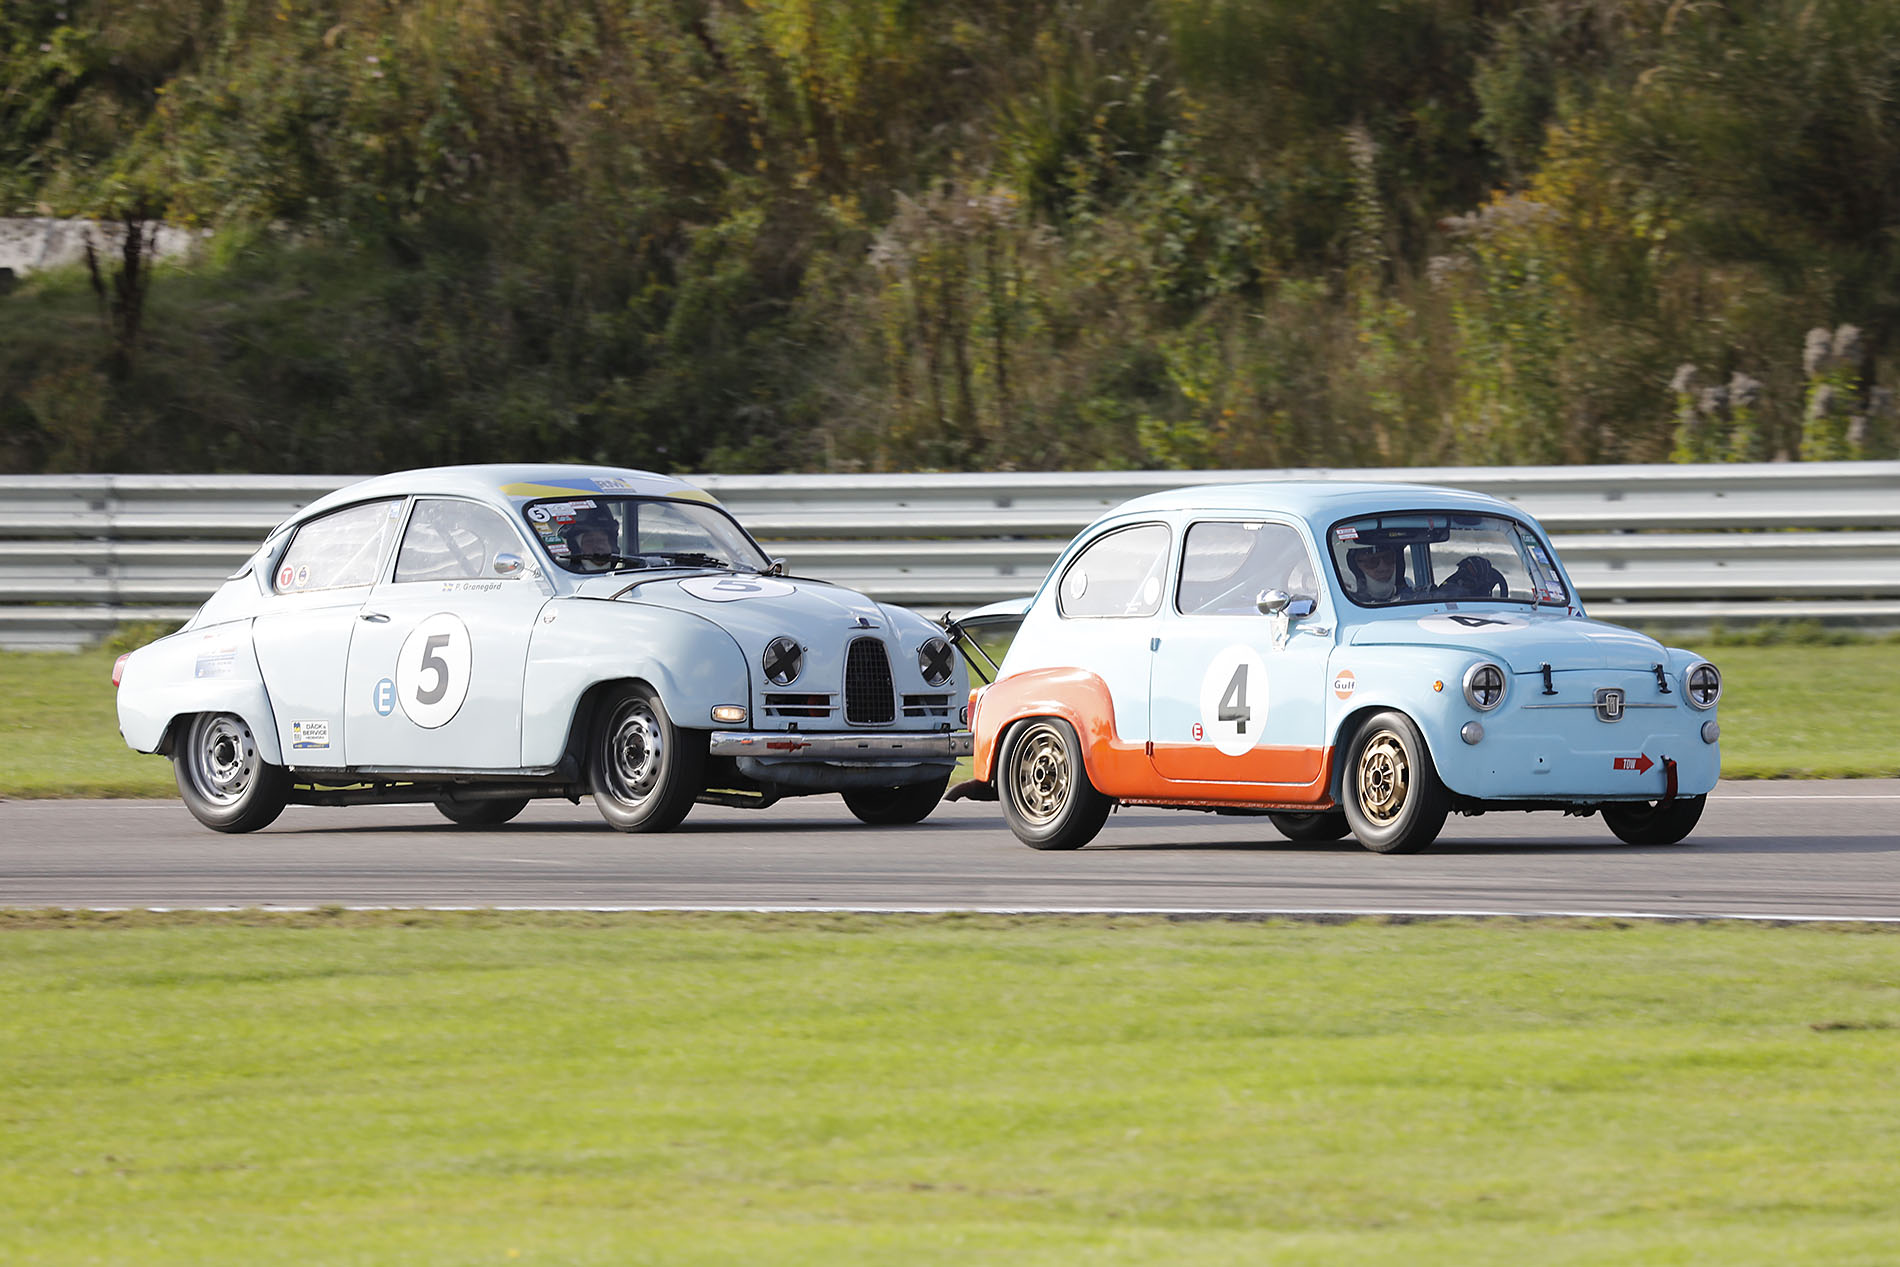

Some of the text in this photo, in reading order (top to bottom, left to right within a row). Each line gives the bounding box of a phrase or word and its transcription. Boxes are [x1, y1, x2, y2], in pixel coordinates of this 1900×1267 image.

[533, 509, 545, 519] 5
[712, 579, 762, 592] 5
[1447, 615, 1512, 627] 4
[416, 633, 451, 705] 5
[1334, 680, 1355, 690] Gulf
[378, 682, 392, 712] E
[1218, 664, 1251, 734] 4
[1194, 724, 1202, 740] E
[1623, 759, 1637, 769] TOW
